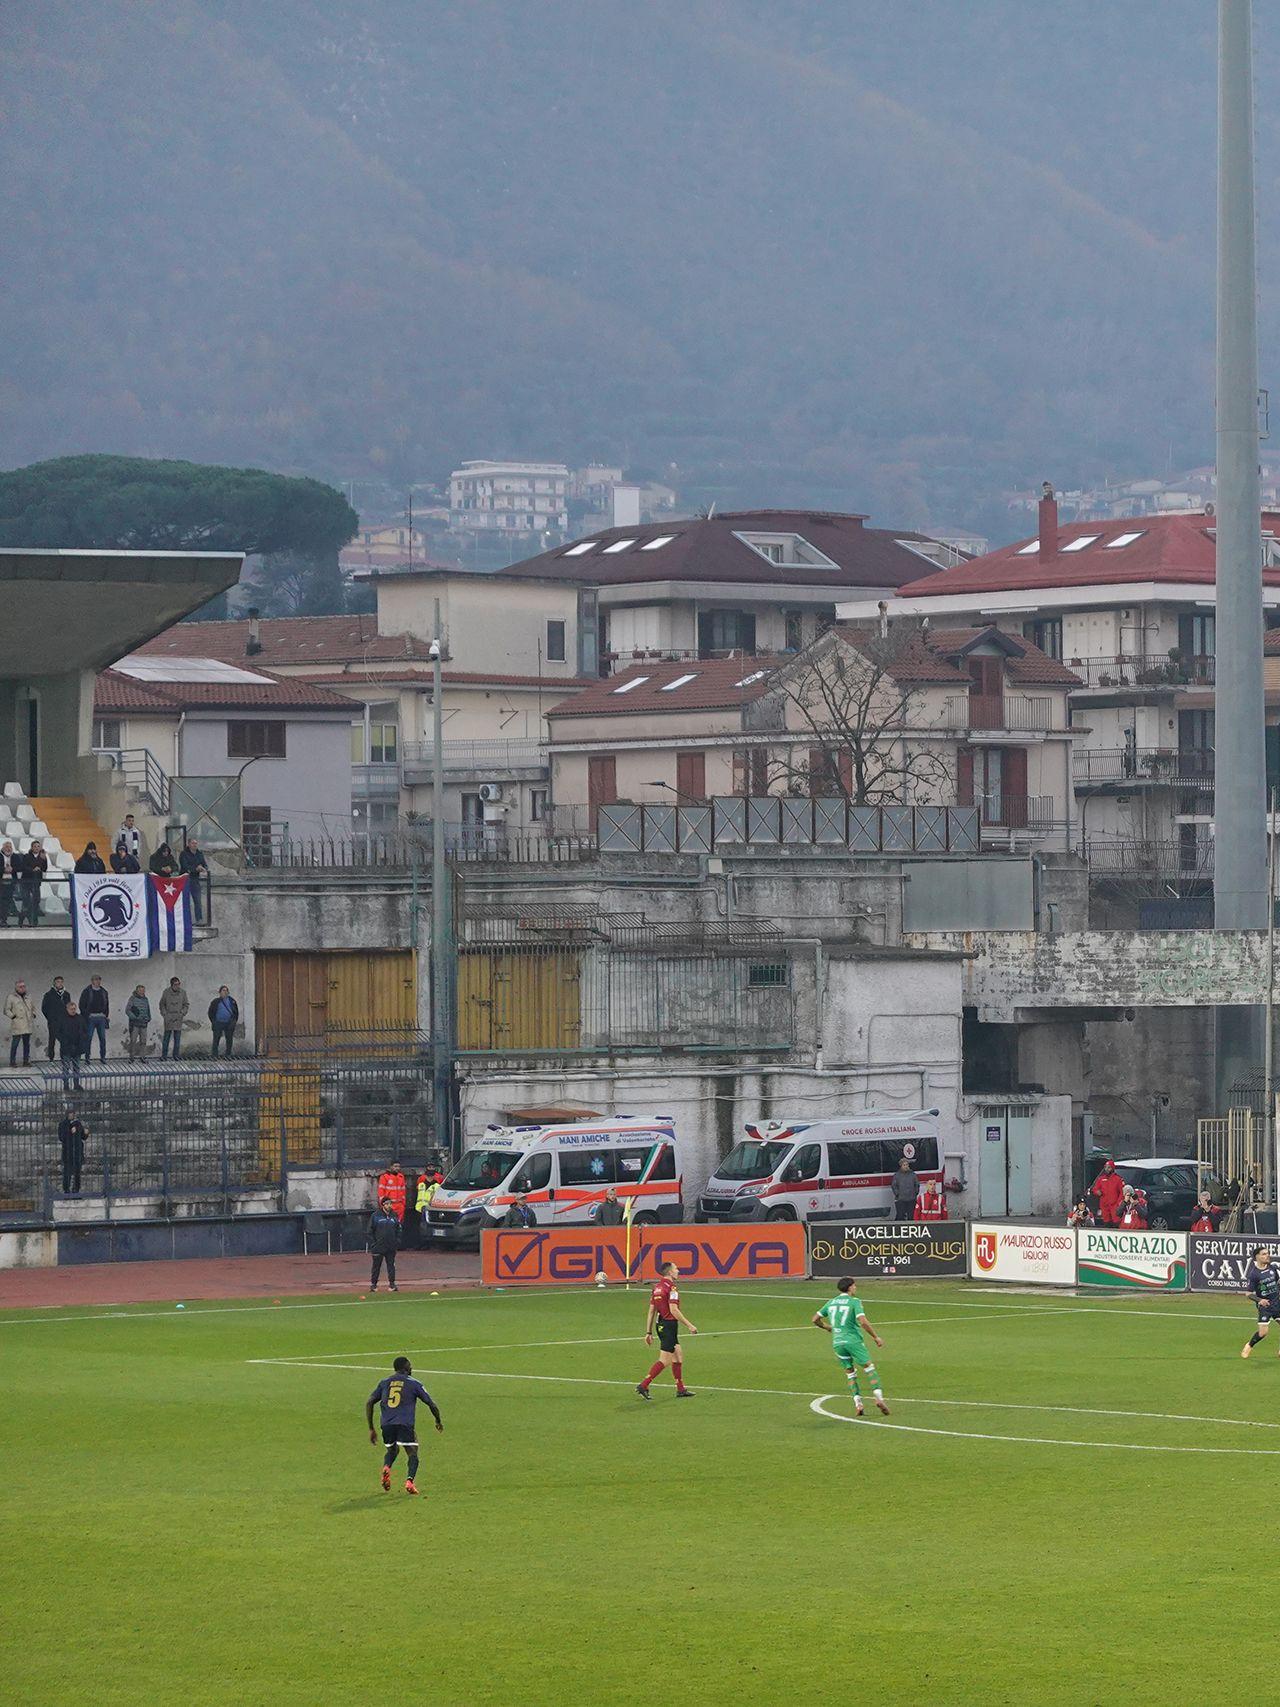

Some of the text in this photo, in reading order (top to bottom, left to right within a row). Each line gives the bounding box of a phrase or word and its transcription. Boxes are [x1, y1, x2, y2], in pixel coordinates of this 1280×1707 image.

[88, 942, 138, 953] M-25-5
[841, 1126, 917, 1136] CROCE ROSSA ITALIANA
[558, 1134, 611, 1145] MANI AMICHE
[844, 1225, 932, 1240] MACELLERIA
[1000, 1234, 1073, 1250] MAURIZIO RUSSO
[1087, 1234, 1178, 1255] PANCRAZIO
[1195, 1239, 1243, 1256] SERVIZI
[839, 1240, 927, 1260] DOMENICO
[927, 1241, 966, 1261] LUIGI
[1022, 1251, 1049, 1261] LIQUORI
[549, 1242, 789, 1279] GIVOVA
[867, 1256, 911, 1265] EST. 1961
[387, 1387, 402, 1409] 5
